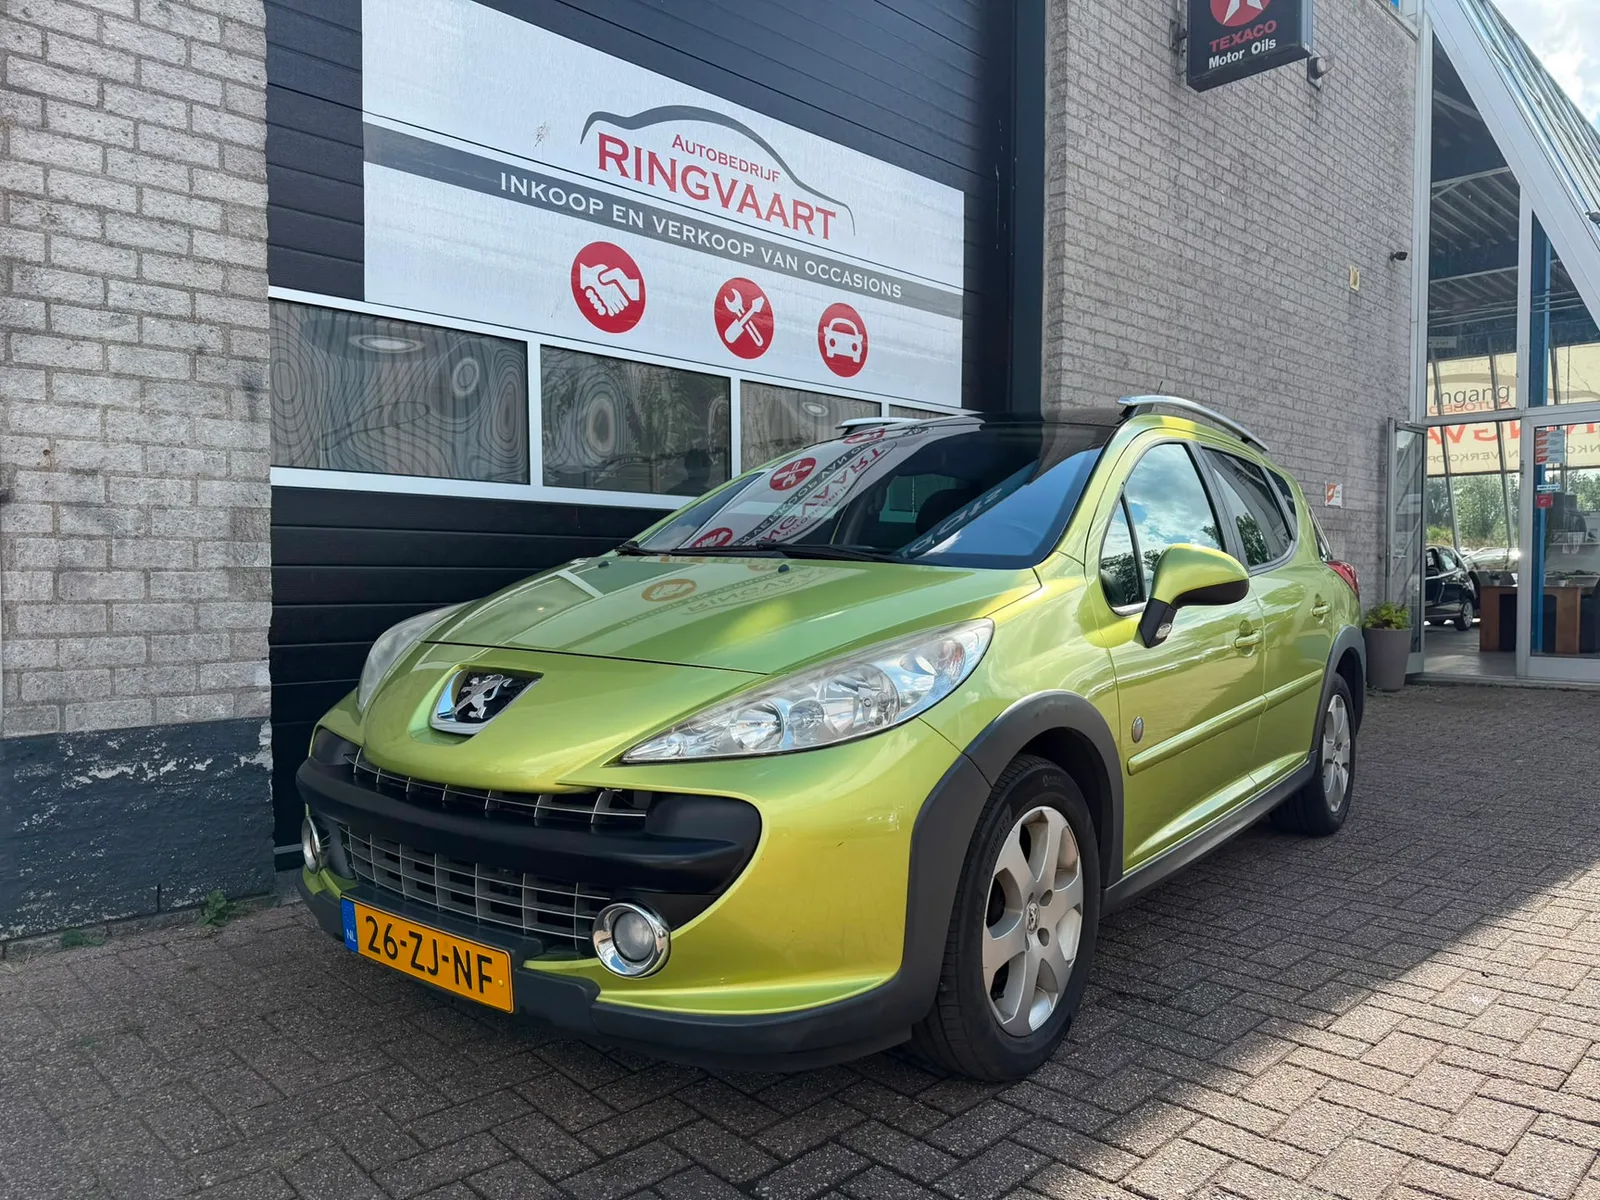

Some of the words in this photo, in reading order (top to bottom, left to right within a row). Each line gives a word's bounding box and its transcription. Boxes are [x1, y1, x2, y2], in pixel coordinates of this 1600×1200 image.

[1208, 49, 1245, 69] Motor
[1251, 38, 1277, 55] Oils
[1209, 20, 1277, 52] TEXACO
[671, 134, 781, 183] AUTOBEDRIJF
[597, 132, 837, 240] RINGVAART
[500, 172, 604, 215] INKOOP
[613, 206, 644, 229] EN
[653, 216, 755, 258] VERKOOP
[761, 248, 798, 272] VAN
[805, 260, 902, 299] OCCASIONS
[1434, 386, 1510, 408] Ingang
[346, 929, 356, 942] NL
[366, 915, 493, 993] 26-ZJ-NF
